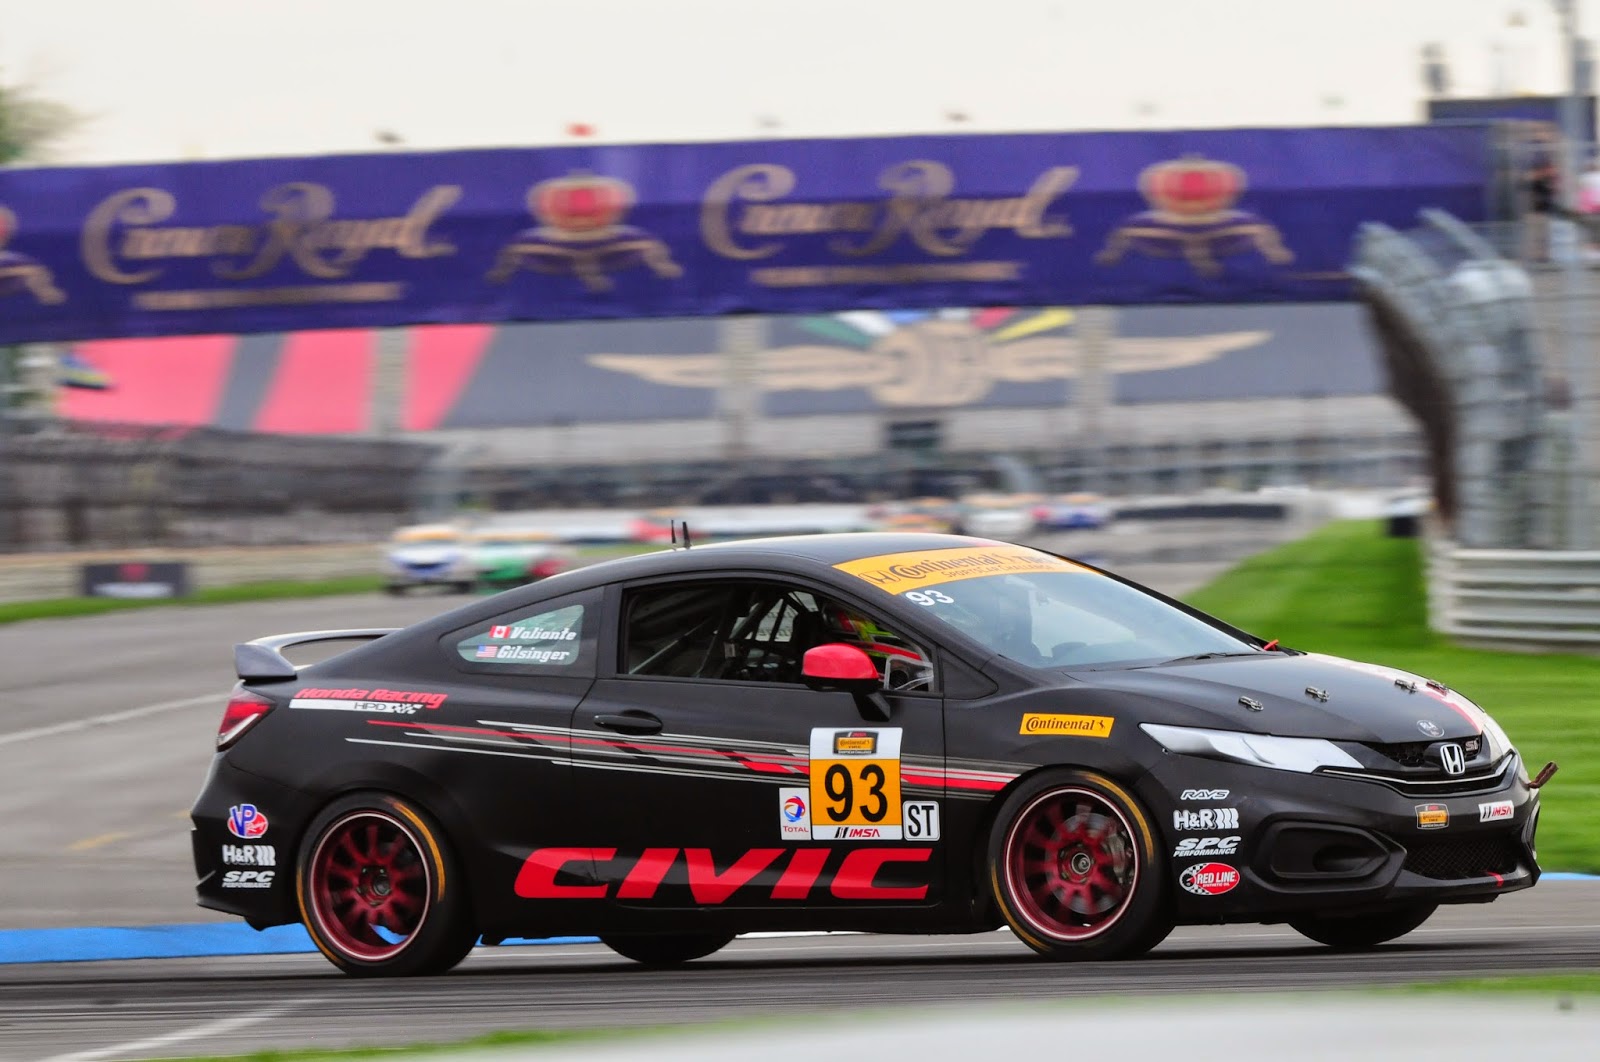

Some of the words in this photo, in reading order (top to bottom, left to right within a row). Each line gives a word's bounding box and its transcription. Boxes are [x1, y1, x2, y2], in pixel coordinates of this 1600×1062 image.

[829, 159, 1080, 256] Royal
[211, 181, 463, 279] Royal
[888, 552, 1003, 580] Continental
[905, 589, 954, 607] 93
[510, 626, 577, 641] Valiante
[497, 645, 570, 662] Gilsinger
[294, 688, 370, 700] Honda
[367, 688, 448, 709] Racing
[353, 701, 387, 711] HPD
[1026, 716, 1095, 732] Continental
[824, 763, 888, 823] 93
[1180, 789, 1230, 800] RAYS
[1173, 808, 1217, 831] H&R
[1492, 805, 1512, 817] IMSA
[229, 804, 258, 837] VP
[783, 825, 809, 833] TOTAL
[907, 804, 935, 837] ST
[849, 828, 880, 838] IMSA
[1173, 847, 1236, 857] PERFORMANCE
[1175, 836, 1242, 851] SPC
[222, 844, 256, 865] H&R
[222, 870, 275, 883] SPC
[513, 847, 933, 904] CIVIC
[1197, 873, 1214, 884] RED
[1215, 871, 1236, 883] LINE
